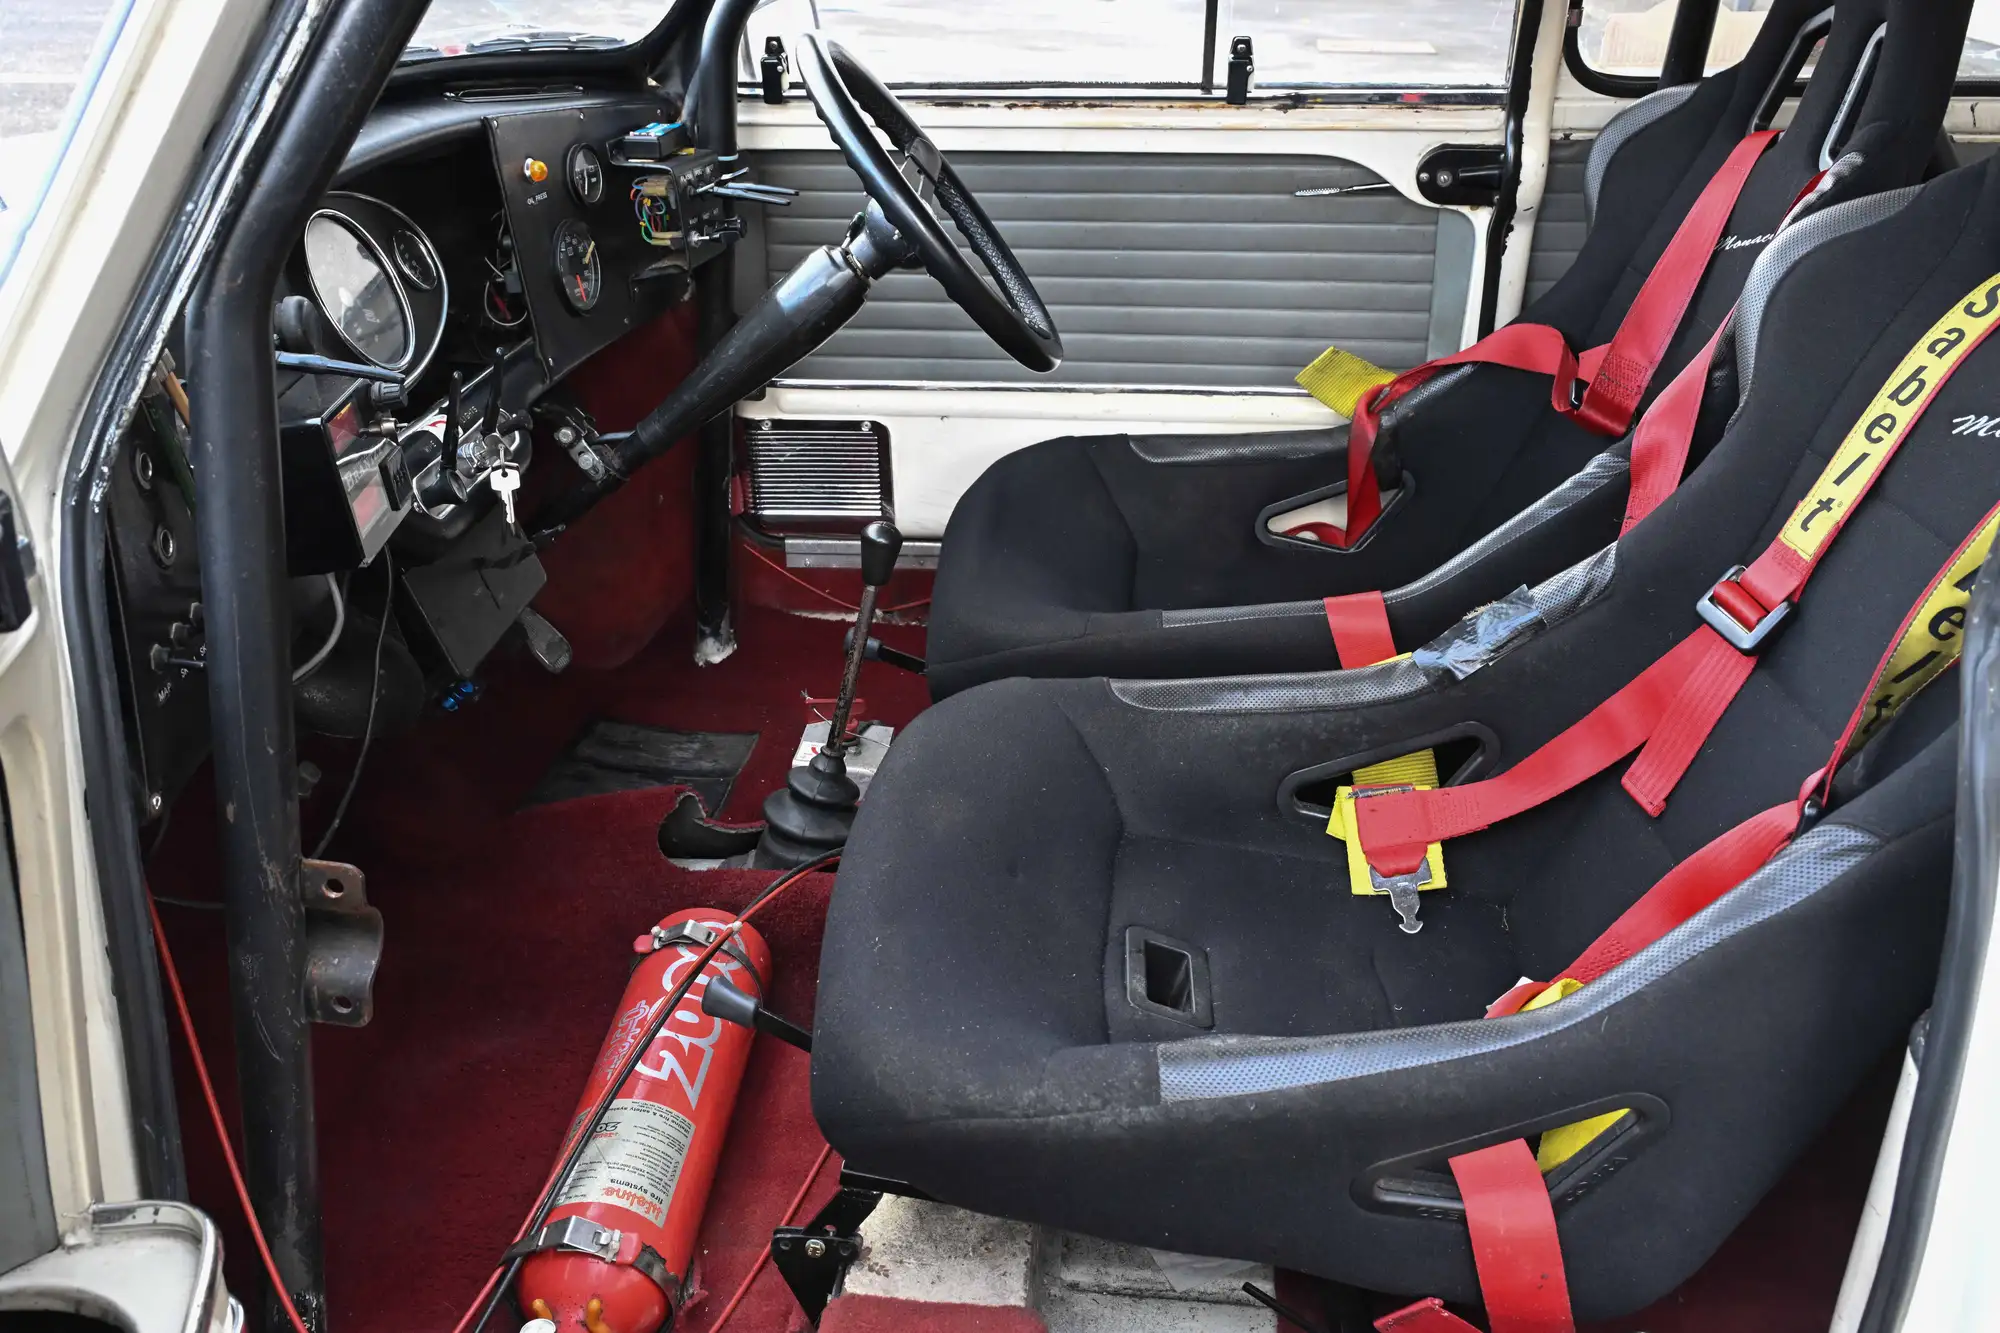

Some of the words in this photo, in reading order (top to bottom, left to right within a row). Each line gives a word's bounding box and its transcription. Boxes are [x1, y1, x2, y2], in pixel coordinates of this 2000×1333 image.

[1800, 283, 2000, 532] Sabelt
[610, 1178, 647, 1194] systems
[650, 1192, 663, 1204] fire
